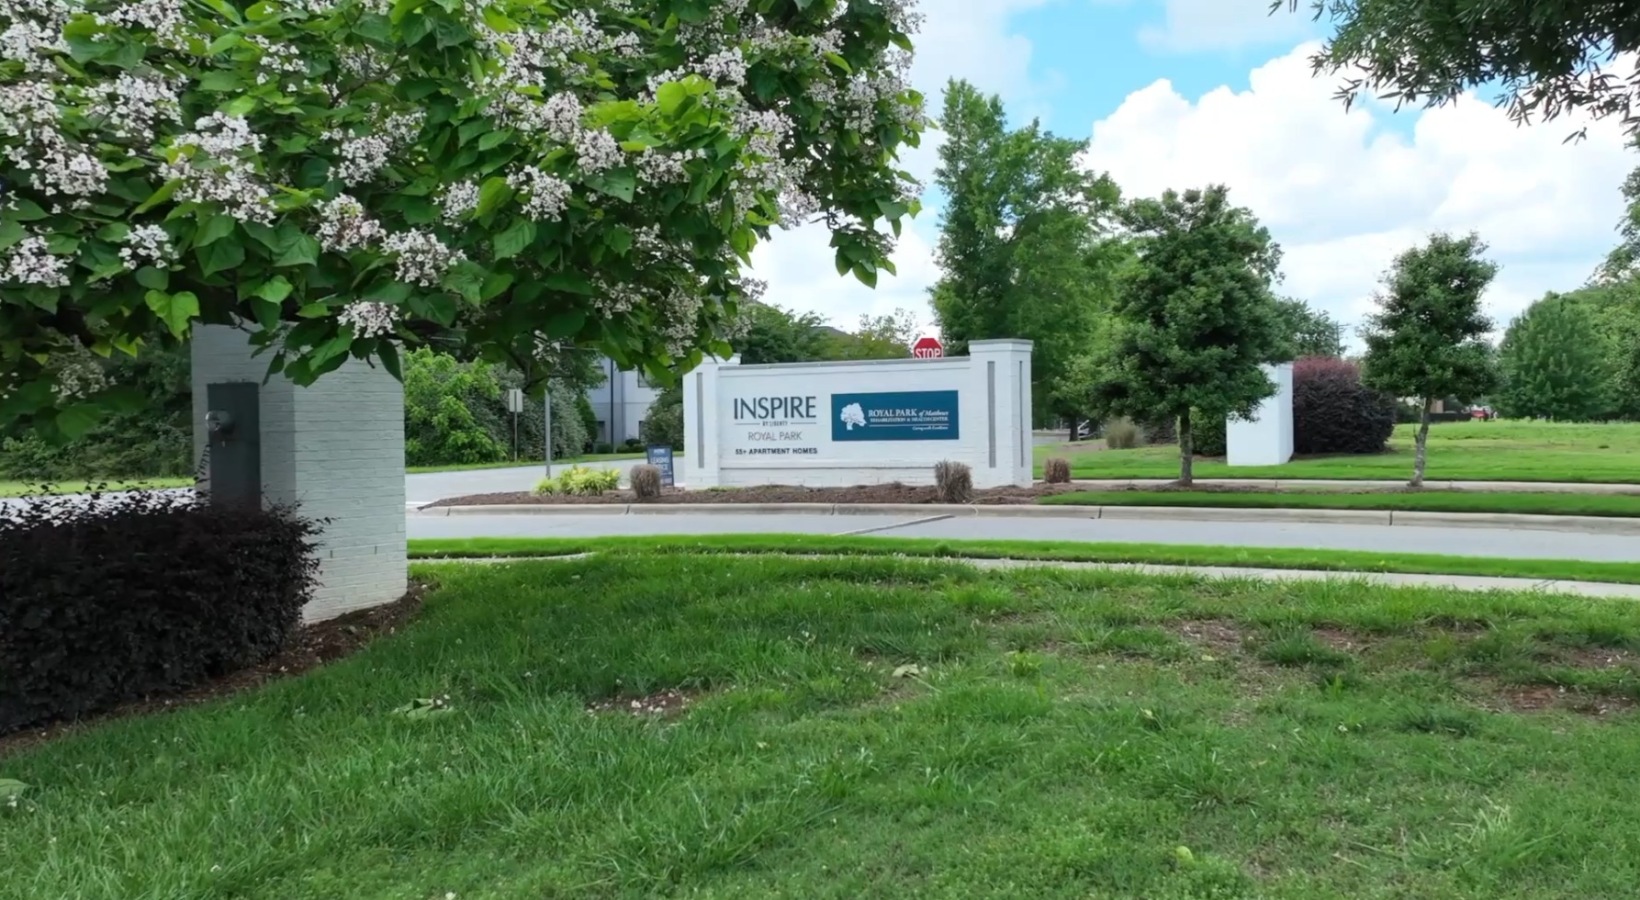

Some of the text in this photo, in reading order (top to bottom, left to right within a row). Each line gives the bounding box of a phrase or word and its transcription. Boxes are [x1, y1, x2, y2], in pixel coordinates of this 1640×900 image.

[915, 348, 941, 359] STOP
[734, 396, 817, 420] INSPIRE
[868, 409, 894, 417] ROYAL
[895, 408, 917, 417] PARK
[918, 410, 925, 418] of
[748, 431, 803, 441] ROYAL PARK
[792, 447, 818, 455] HOMES
